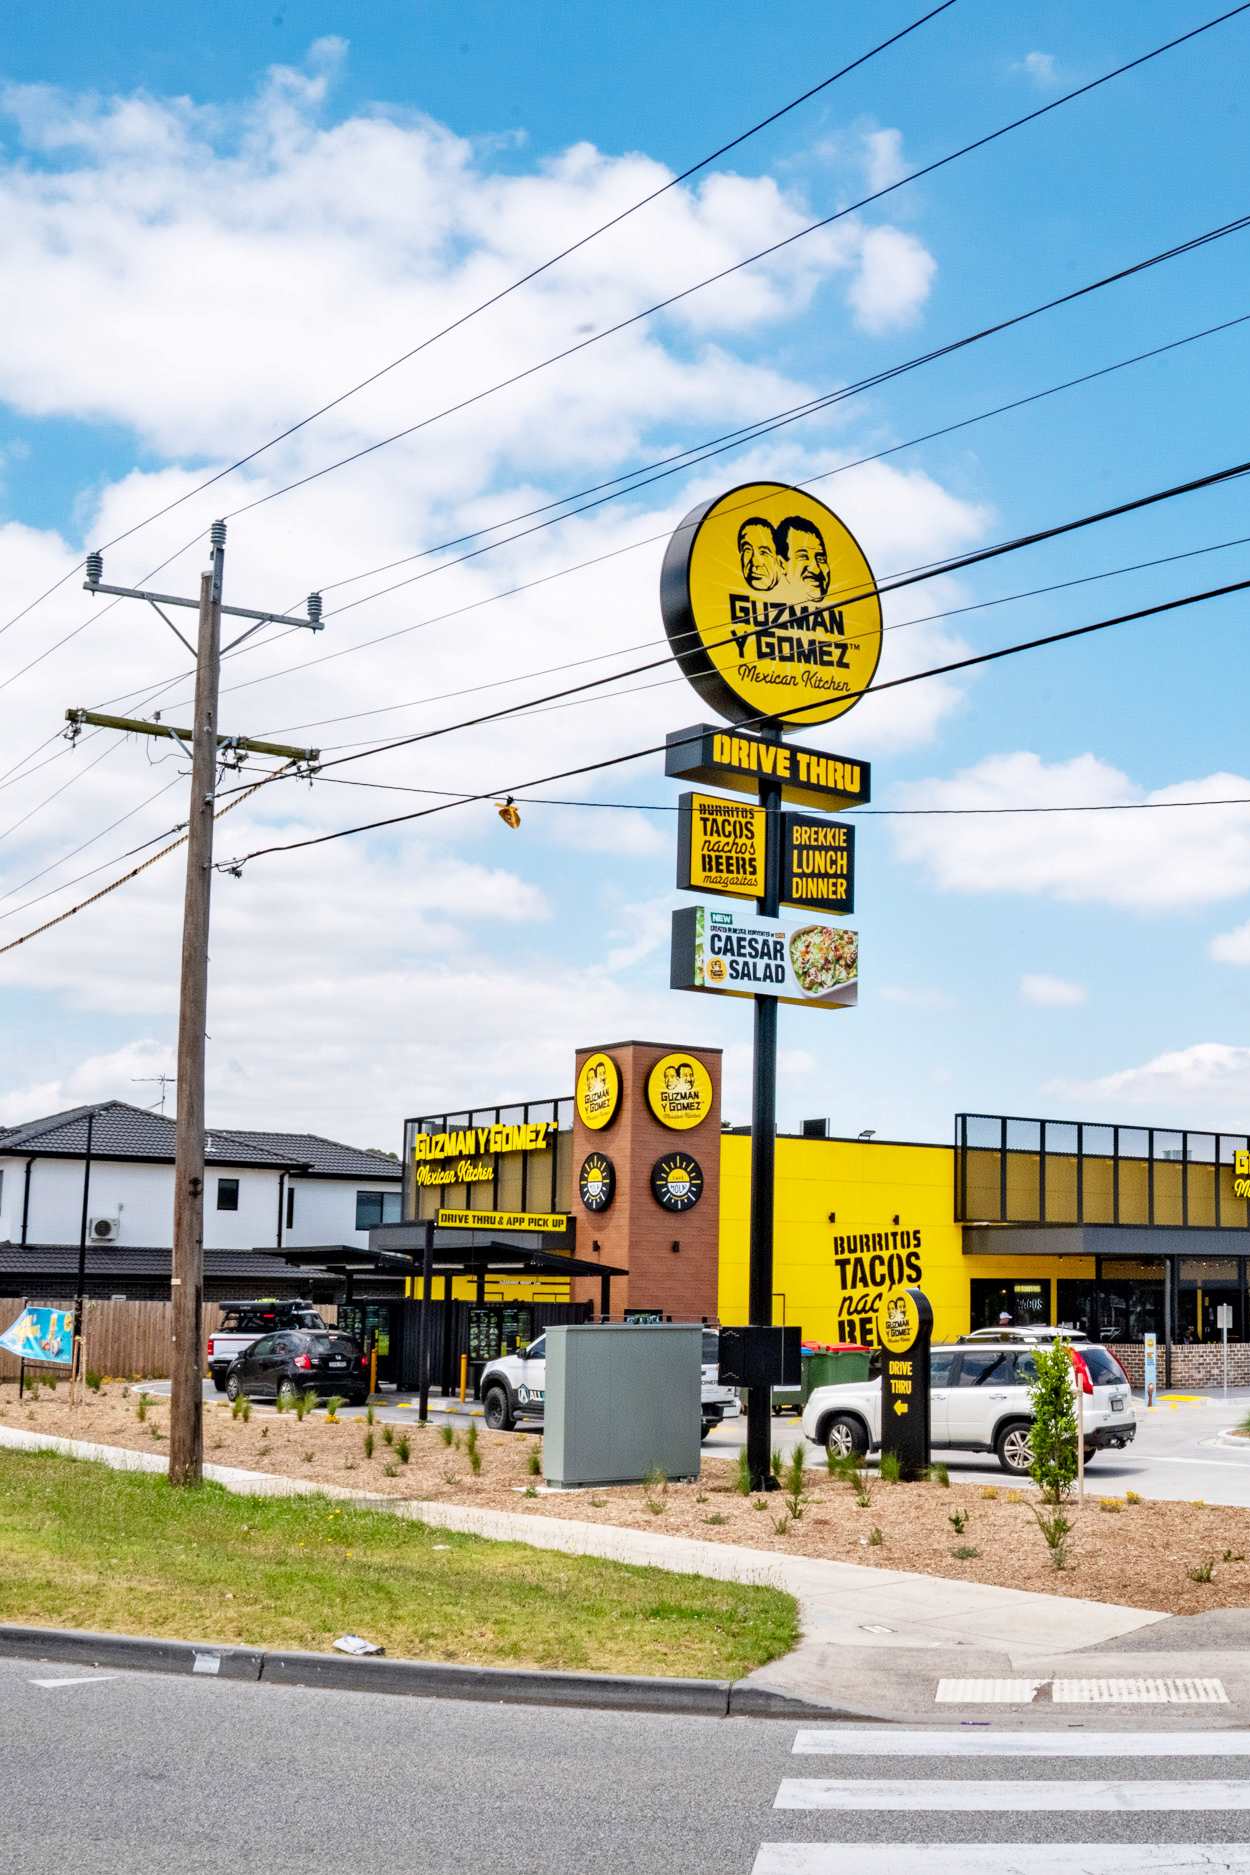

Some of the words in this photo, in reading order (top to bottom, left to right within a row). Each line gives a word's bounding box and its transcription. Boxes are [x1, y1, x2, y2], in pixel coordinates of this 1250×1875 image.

[729, 594, 845, 636] GUZMAN
[731, 630, 749, 659] Y
[757, 631, 850, 668] GOMEZ
[738, 664, 798, 687] Mexican
[801, 670, 850, 692] Kitchen
[713, 734, 791, 777] DRIVE
[797, 753, 861, 793] THRU
[699, 804, 755, 819] BURRITOS
[700, 817, 755, 840] TACOS
[792, 825, 847, 847] BREKKIE
[701, 838, 756, 855] nachos
[702, 854, 757, 875] BEERS
[792, 850, 847, 874] LUNCH
[703, 876, 758, 888] margaritas
[792, 877, 847, 899] DINNER
[711, 913, 731, 924] NEW
[710, 933, 785, 961] CAESAR
[729, 959, 785, 984] SALAD
[584, 1089, 610, 1104] GUZMAN
[589, 1100, 610, 1113] GOMEZ
[661, 1092, 699, 1102] GUZMAN
[661, 1104, 667, 1112] Y
[669, 1102, 701, 1112] GOMEZ
[415, 1130, 475, 1160] GUZMAN
[477, 1127, 490, 1154] Y
[489, 1122, 547, 1152] GOMEZ
[416, 1165, 456, 1186] Mexican
[457, 1160, 494, 1182] Kitchen
[441, 1213, 469, 1224] DRIVE
[472, 1215, 496, 1225] THRU
[498, 1217, 504, 1225] &
[506, 1216, 525, 1226] APP
[528, 1217, 548, 1227] PICK
[552, 1218, 564, 1228] UP
[833, 1230, 921, 1255] BURRITOS
[835, 1251, 922, 1290] TACOS
[838, 1292, 884, 1317] nac
[886, 1320, 909, 1329] GUZMAN
[889, 1361, 912, 1375] DRIVE
[890, 1380, 912, 1394] THRU
